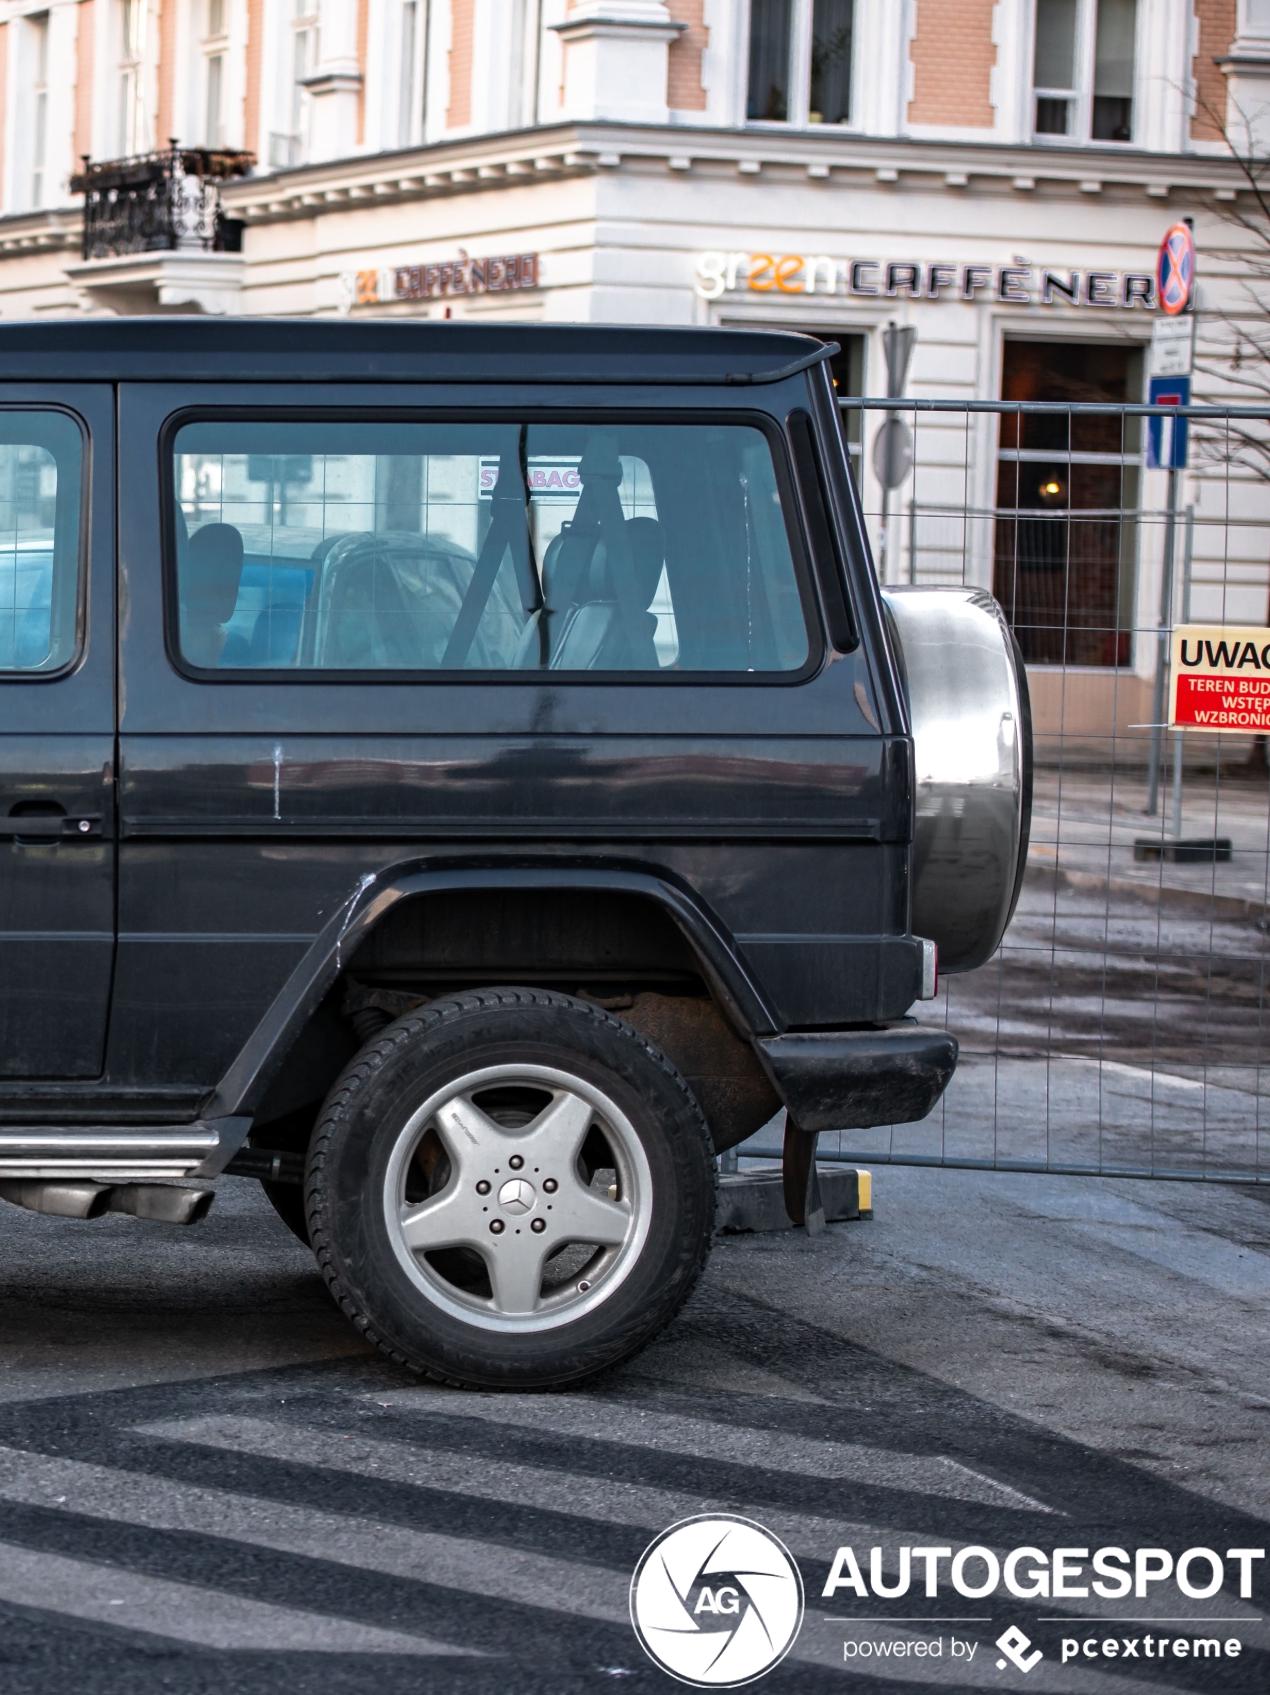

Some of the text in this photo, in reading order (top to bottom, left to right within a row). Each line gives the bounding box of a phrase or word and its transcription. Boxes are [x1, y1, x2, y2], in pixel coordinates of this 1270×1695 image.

[480, 469, 580, 488] STBAG
[1188, 678, 1270, 695] TEREN BUD
[1222, 695, 1270, 713] WSTĘP
